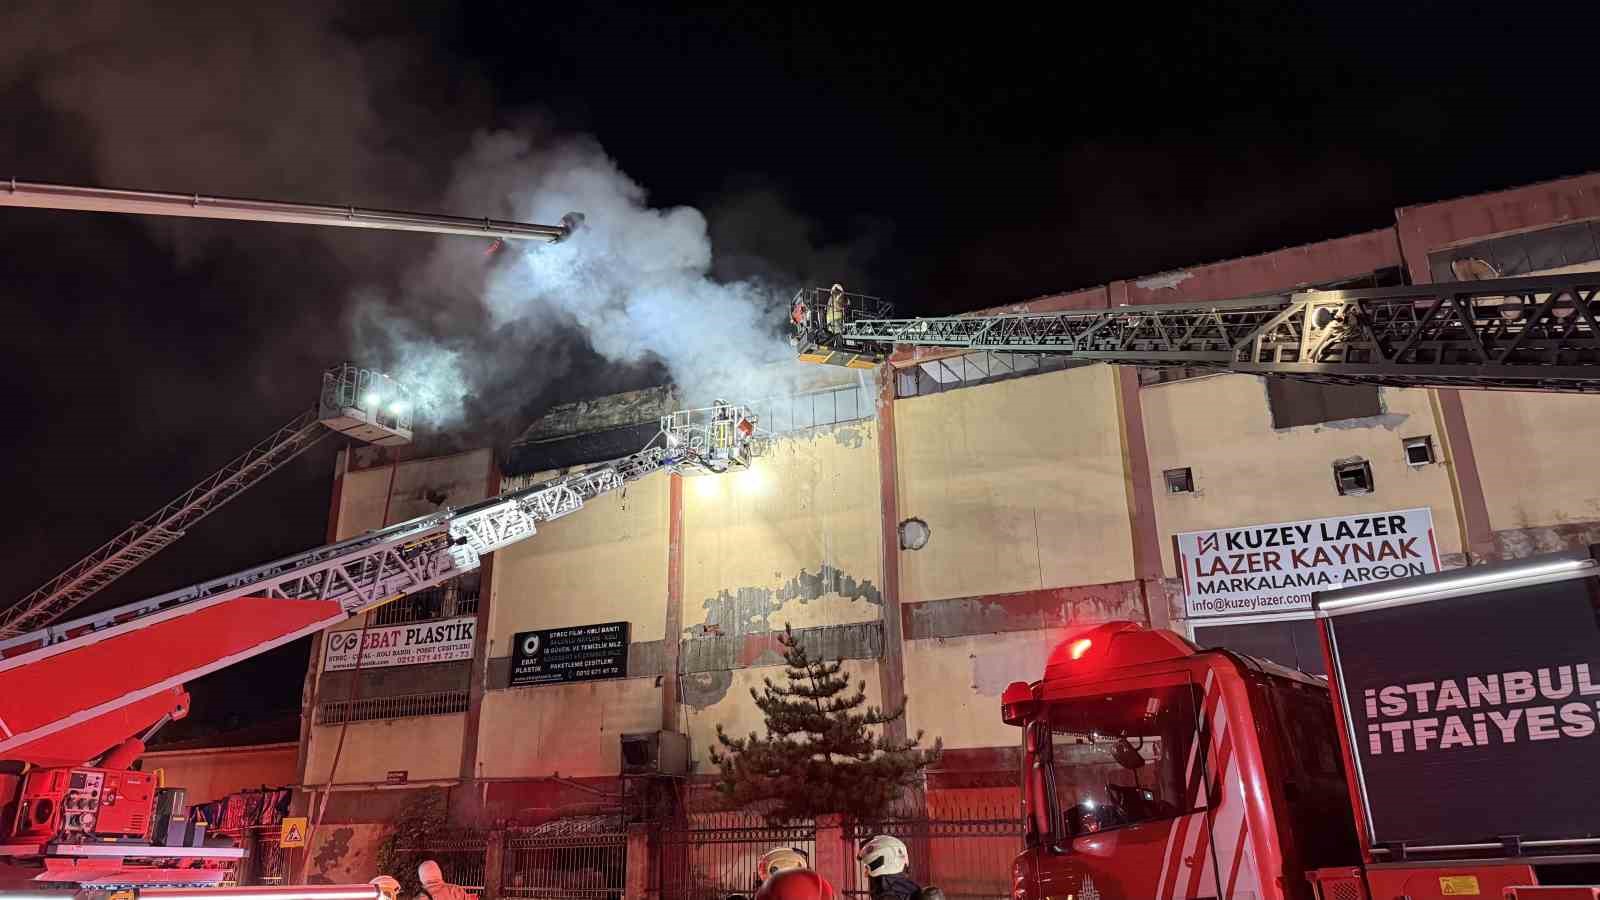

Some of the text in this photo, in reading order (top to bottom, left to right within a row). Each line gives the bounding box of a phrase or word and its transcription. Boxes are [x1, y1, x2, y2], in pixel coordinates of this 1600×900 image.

[1226, 515, 1407, 550] KUZEY LAZER
[1195, 537, 1422, 577] LAZER KAYNAK
[1197, 561, 1426, 595] MARKALAMA ARGON
[1192, 593, 1312, 612] info@kuzeylazer.com
[362, 620, 474, 649] EBAT PLASTİK
